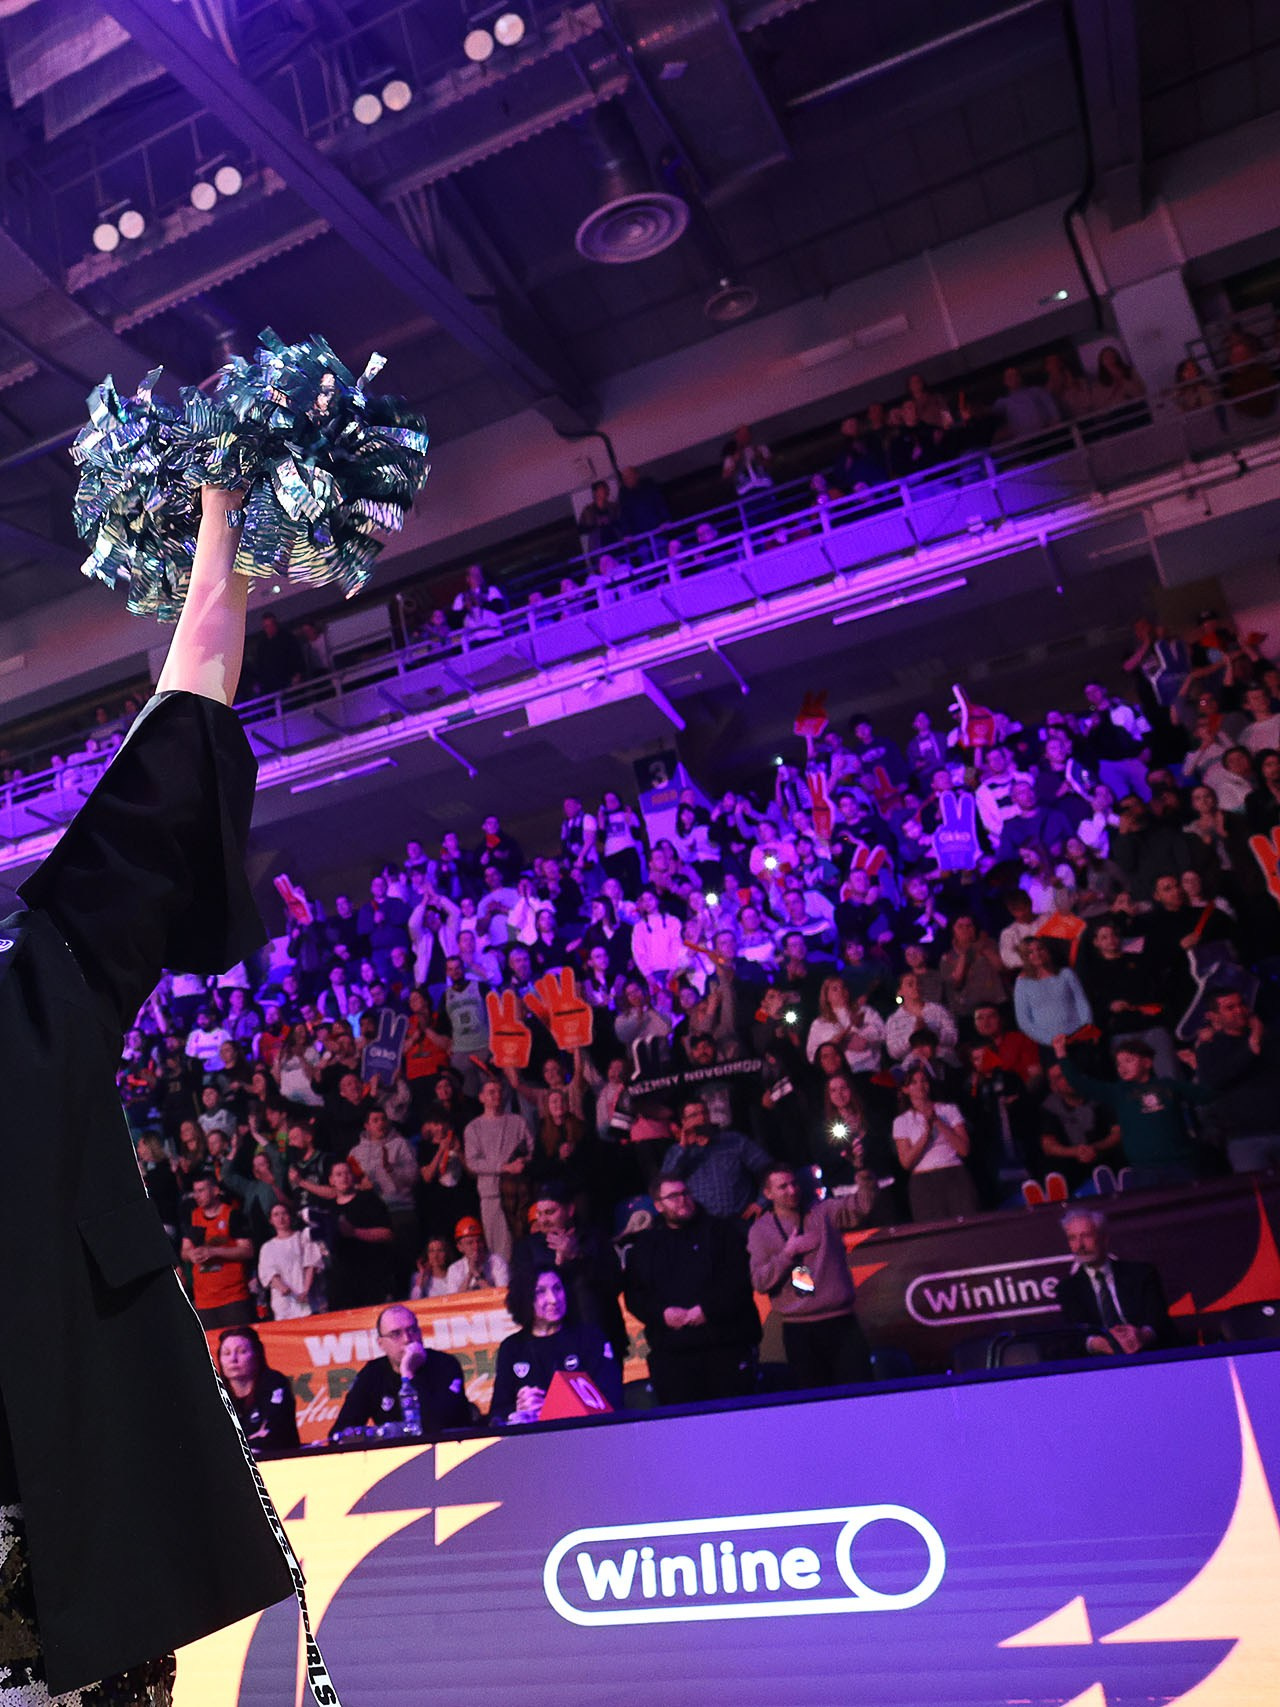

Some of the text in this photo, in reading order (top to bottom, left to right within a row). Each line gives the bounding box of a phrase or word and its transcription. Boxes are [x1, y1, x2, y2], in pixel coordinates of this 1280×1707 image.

[923, 1276, 1060, 1314] Winline
[304, 1310, 523, 1367] WIINE
[576, 1540, 821, 1601] Winline
